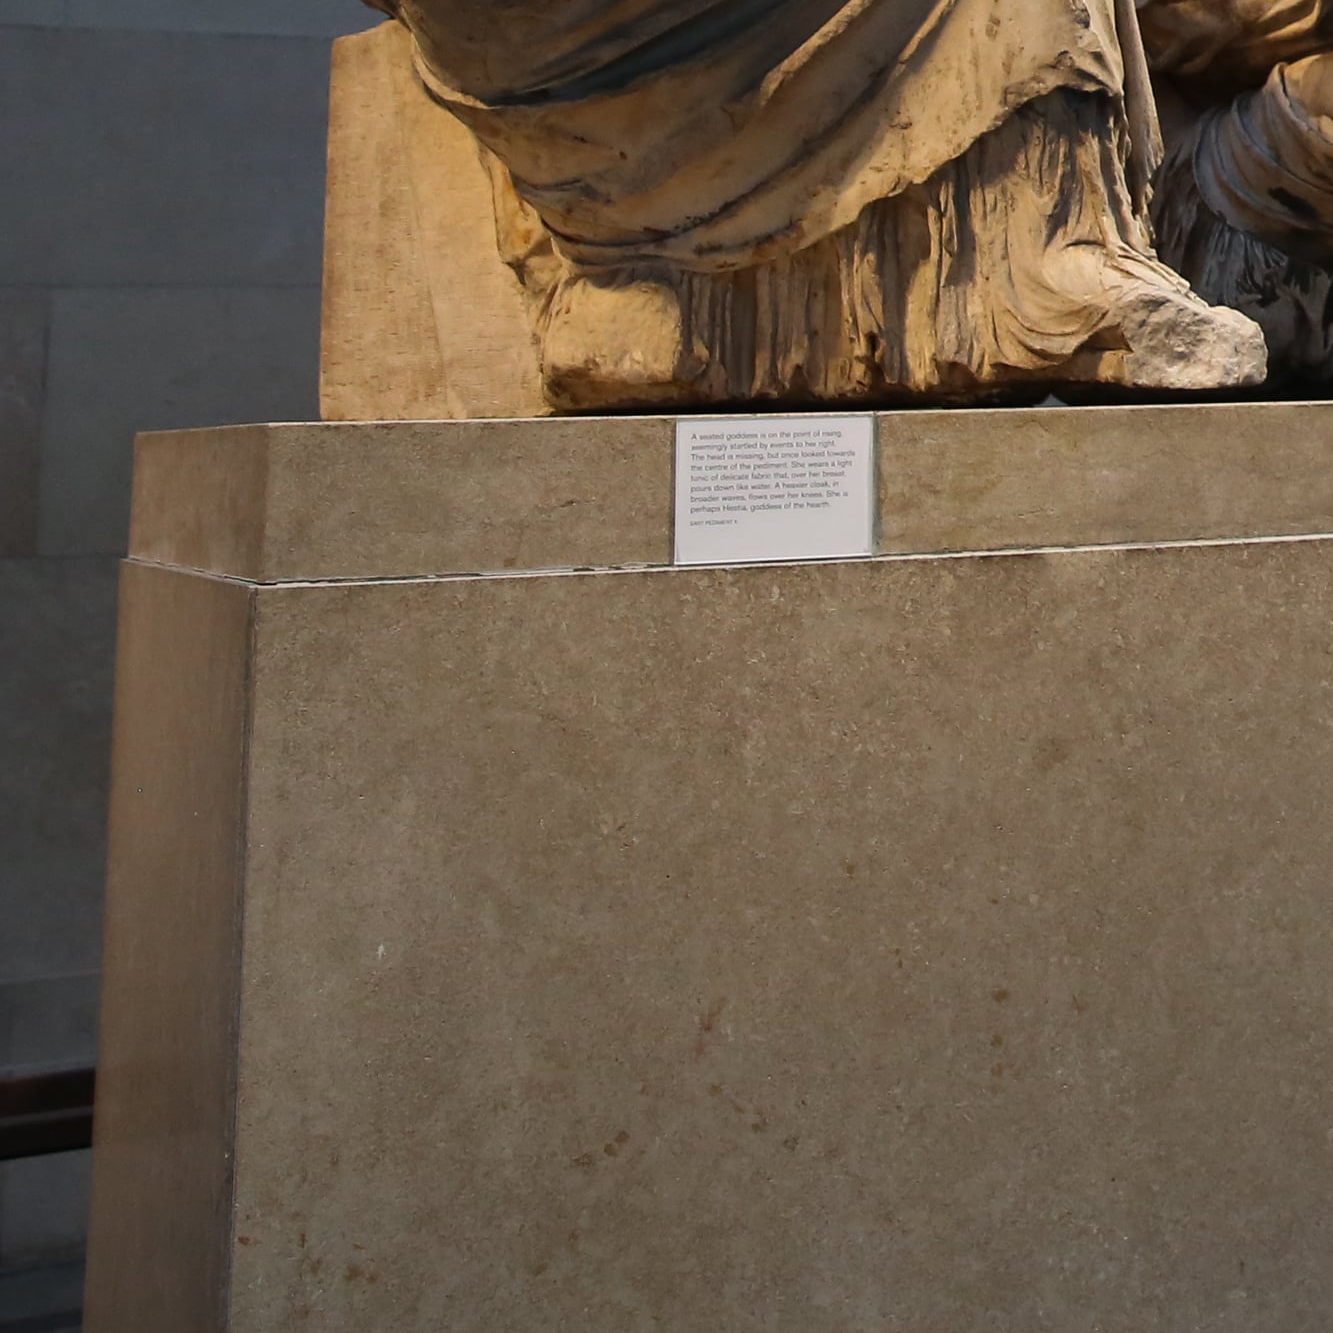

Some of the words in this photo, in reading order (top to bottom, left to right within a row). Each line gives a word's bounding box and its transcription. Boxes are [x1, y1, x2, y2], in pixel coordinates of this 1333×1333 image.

[726, 432, 759, 441] goddess
[793, 431, 811, 439] point
[837, 460, 853, 468] light
[720, 473, 749, 481] delicate
[690, 486, 712, 494] pours
[690, 495, 720, 503] broader
[690, 505, 721, 515] perhaps
[750, 503, 782, 512] goddess
